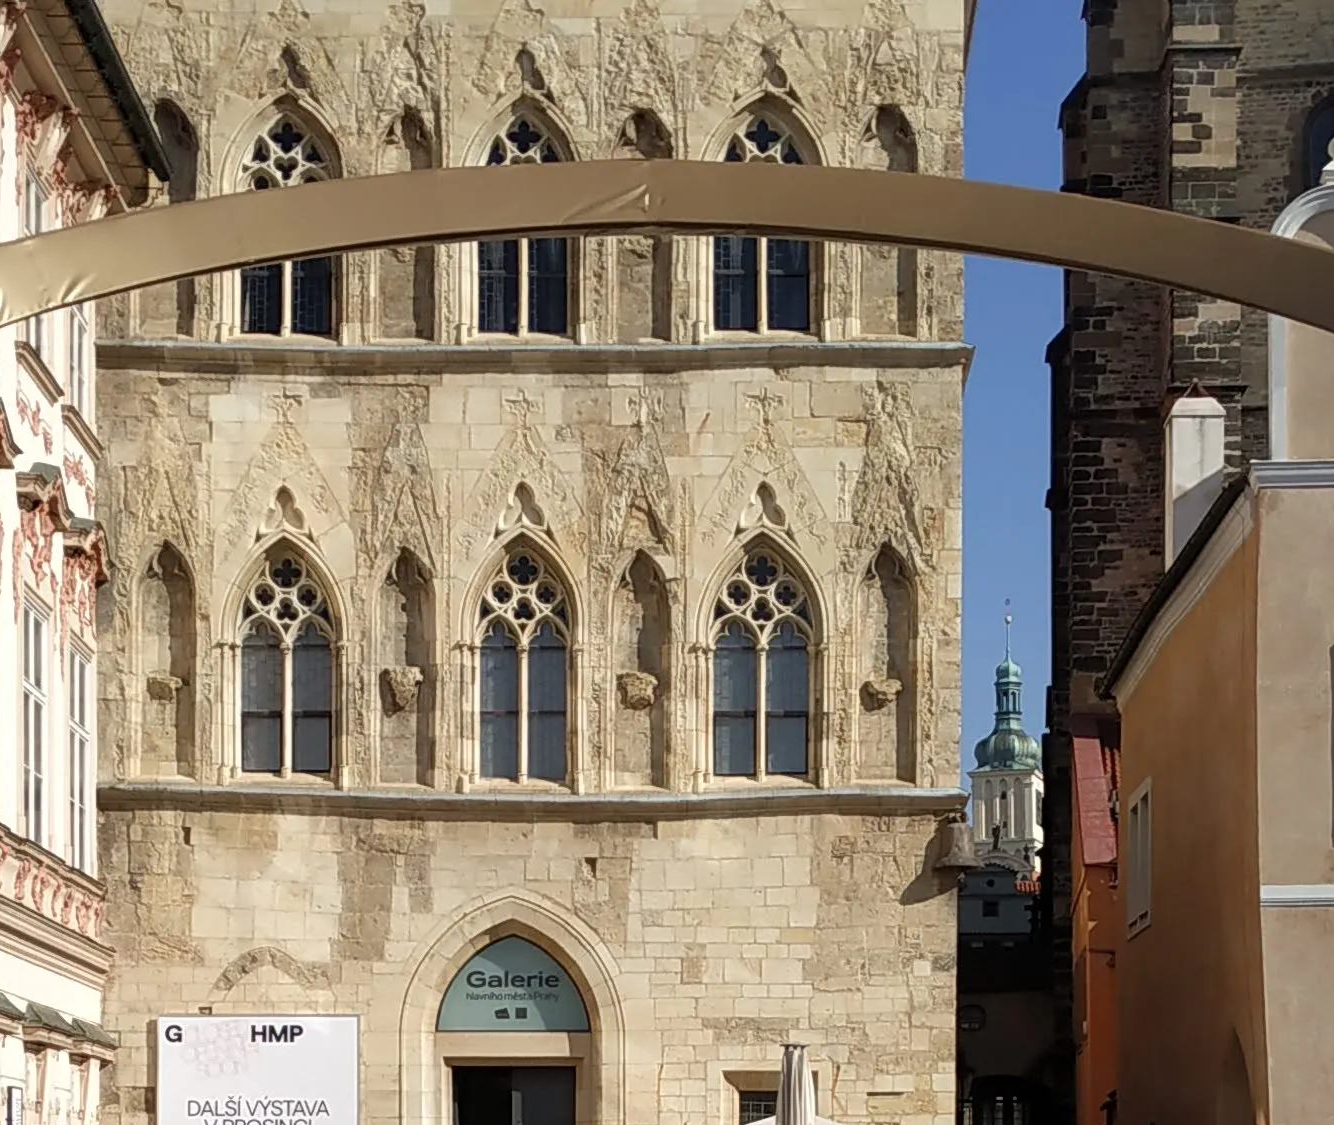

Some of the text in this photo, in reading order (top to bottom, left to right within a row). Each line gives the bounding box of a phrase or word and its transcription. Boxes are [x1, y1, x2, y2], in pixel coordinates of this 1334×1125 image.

[466, 970, 560, 988] Galerie
[466, 991, 503, 1000] hlavního
[165, 1024, 304, 1043] G HMP
[187, 1095, 330, 1116] DALŠÍ VÝSTAVA
